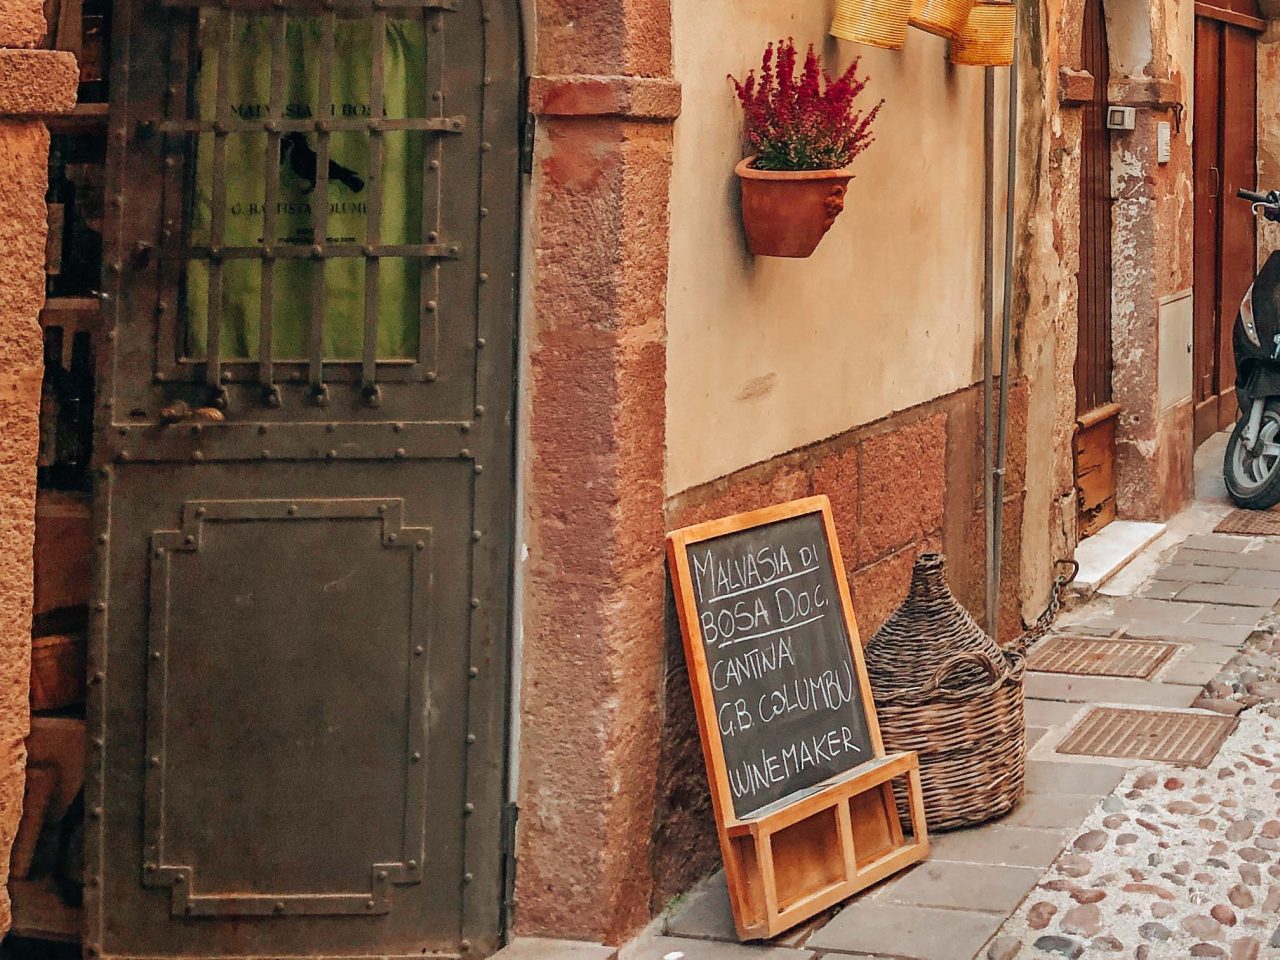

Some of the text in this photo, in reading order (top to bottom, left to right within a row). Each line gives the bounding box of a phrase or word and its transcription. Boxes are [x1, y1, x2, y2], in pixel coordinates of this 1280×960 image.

[693, 545, 793, 603] MALVASIA
[701, 597, 770, 643] BOSA
[712, 636, 794, 691] CANTINA
[718, 660, 852, 737] G.B. COLUMBU
[729, 726, 861, 798] WINEMAKER
